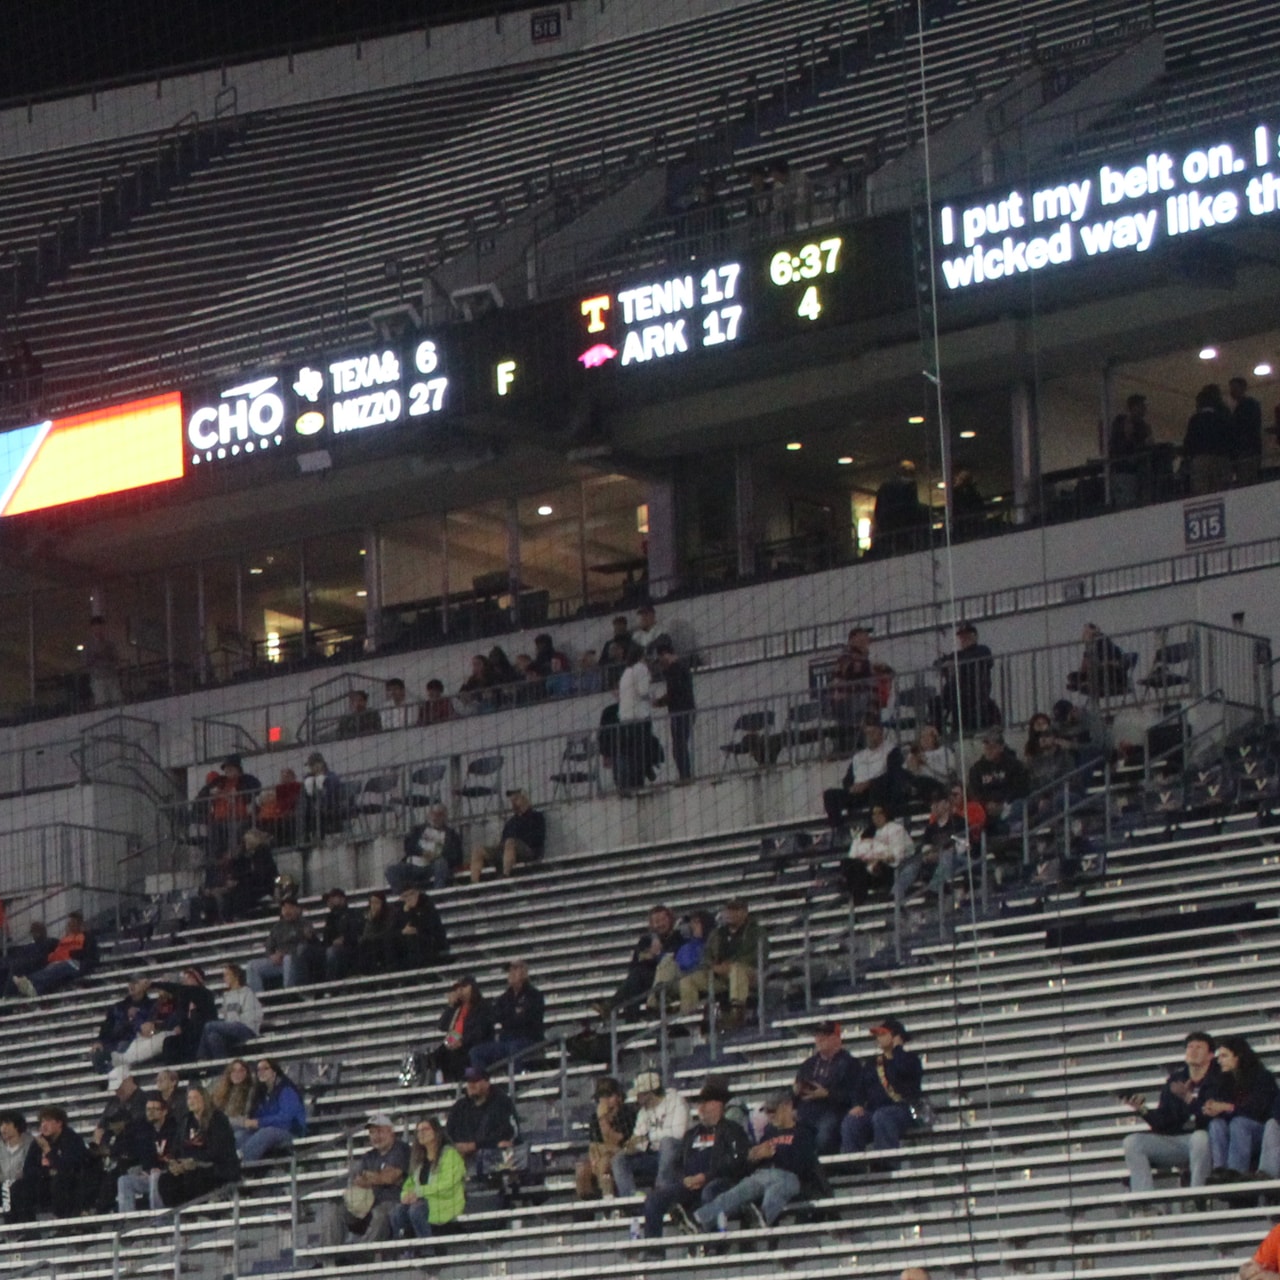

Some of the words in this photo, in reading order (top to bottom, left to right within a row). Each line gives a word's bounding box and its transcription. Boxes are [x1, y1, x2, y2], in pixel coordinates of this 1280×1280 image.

[941, 206, 953, 245] I
[963, 190, 1024, 248] put
[1032, 179, 1090, 222] my
[1100, 153, 1175, 205] belt
[1183, 143, 1244, 183] on.
[1255, 126, 1268, 166] I
[769, 237, 842, 286] 6:37
[942, 222, 1072, 289] wicked
[1080, 209, 1157, 255] way
[1166, 190, 1238, 236] like
[618, 276, 694, 324] TENN
[700, 263, 740, 305] 17
[797, 286, 821, 321] 4
[416, 341, 438, 373] 6
[621, 319, 687, 366] ARK
[702, 305, 742, 346] 17
[332, 389, 401, 433] MIZZO
[409, 377, 448, 416] 27
[496, 361, 516, 395] F
[188, 393, 283, 449] CHO
[1188, 516, 1221, 540] 315
